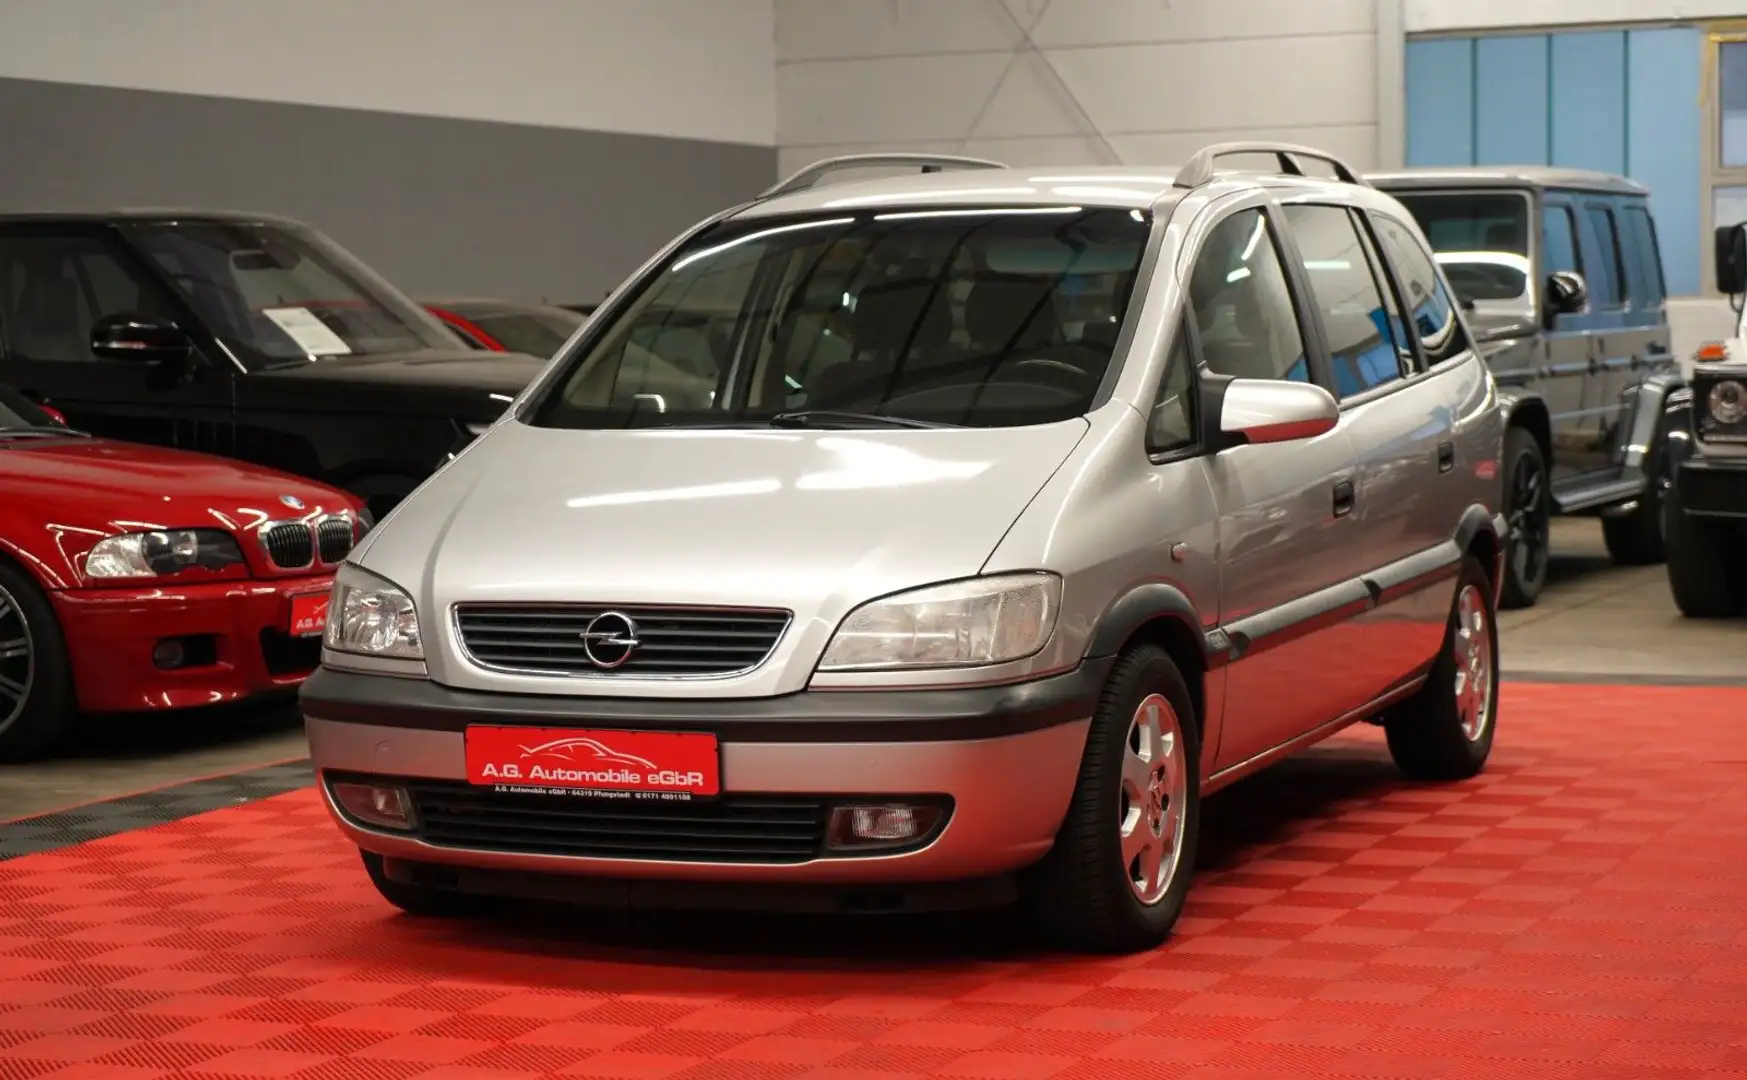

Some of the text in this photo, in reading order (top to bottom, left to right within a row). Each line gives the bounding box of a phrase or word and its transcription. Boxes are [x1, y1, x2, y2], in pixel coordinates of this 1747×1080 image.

[482, 763, 704, 786] A.G. Automobile eGbR
